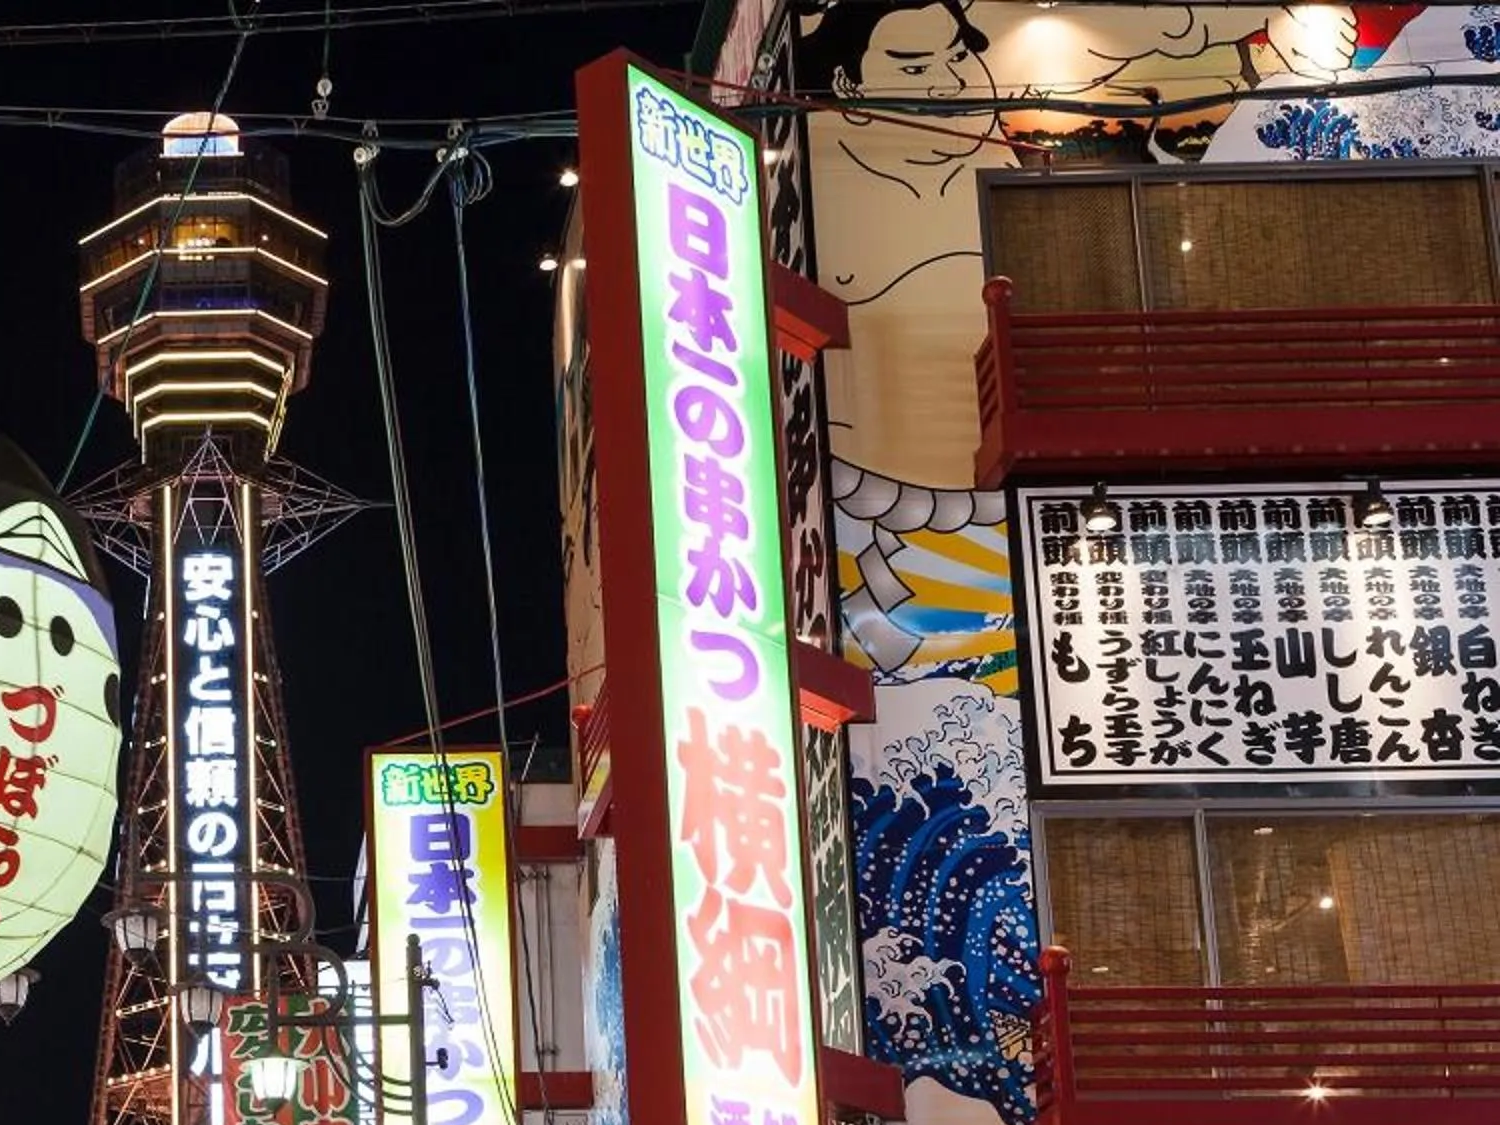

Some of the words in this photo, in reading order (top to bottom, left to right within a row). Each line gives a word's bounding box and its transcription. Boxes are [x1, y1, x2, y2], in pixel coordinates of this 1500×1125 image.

[636, 87, 750, 204] 新世界
[667, 181, 761, 705] 日本一の串かつ
[1052, 632, 1097, 767] もち
[1096, 630, 1146, 766] うずら玉子
[1139, 630, 1192, 765] 紅しょうが
[1184, 630, 1232, 766] にんにく
[1230, 629, 1282, 765] 玉ねぎ
[1275, 628, 1326, 764] 山芋
[1322, 628, 1372, 763] しし唐
[1366, 626, 1419, 762] れんこん
[1410, 626, 1463, 761] 銀杏
[382, 762, 495, 805] 新世界
[675, 701, 804, 1090] 横綱
